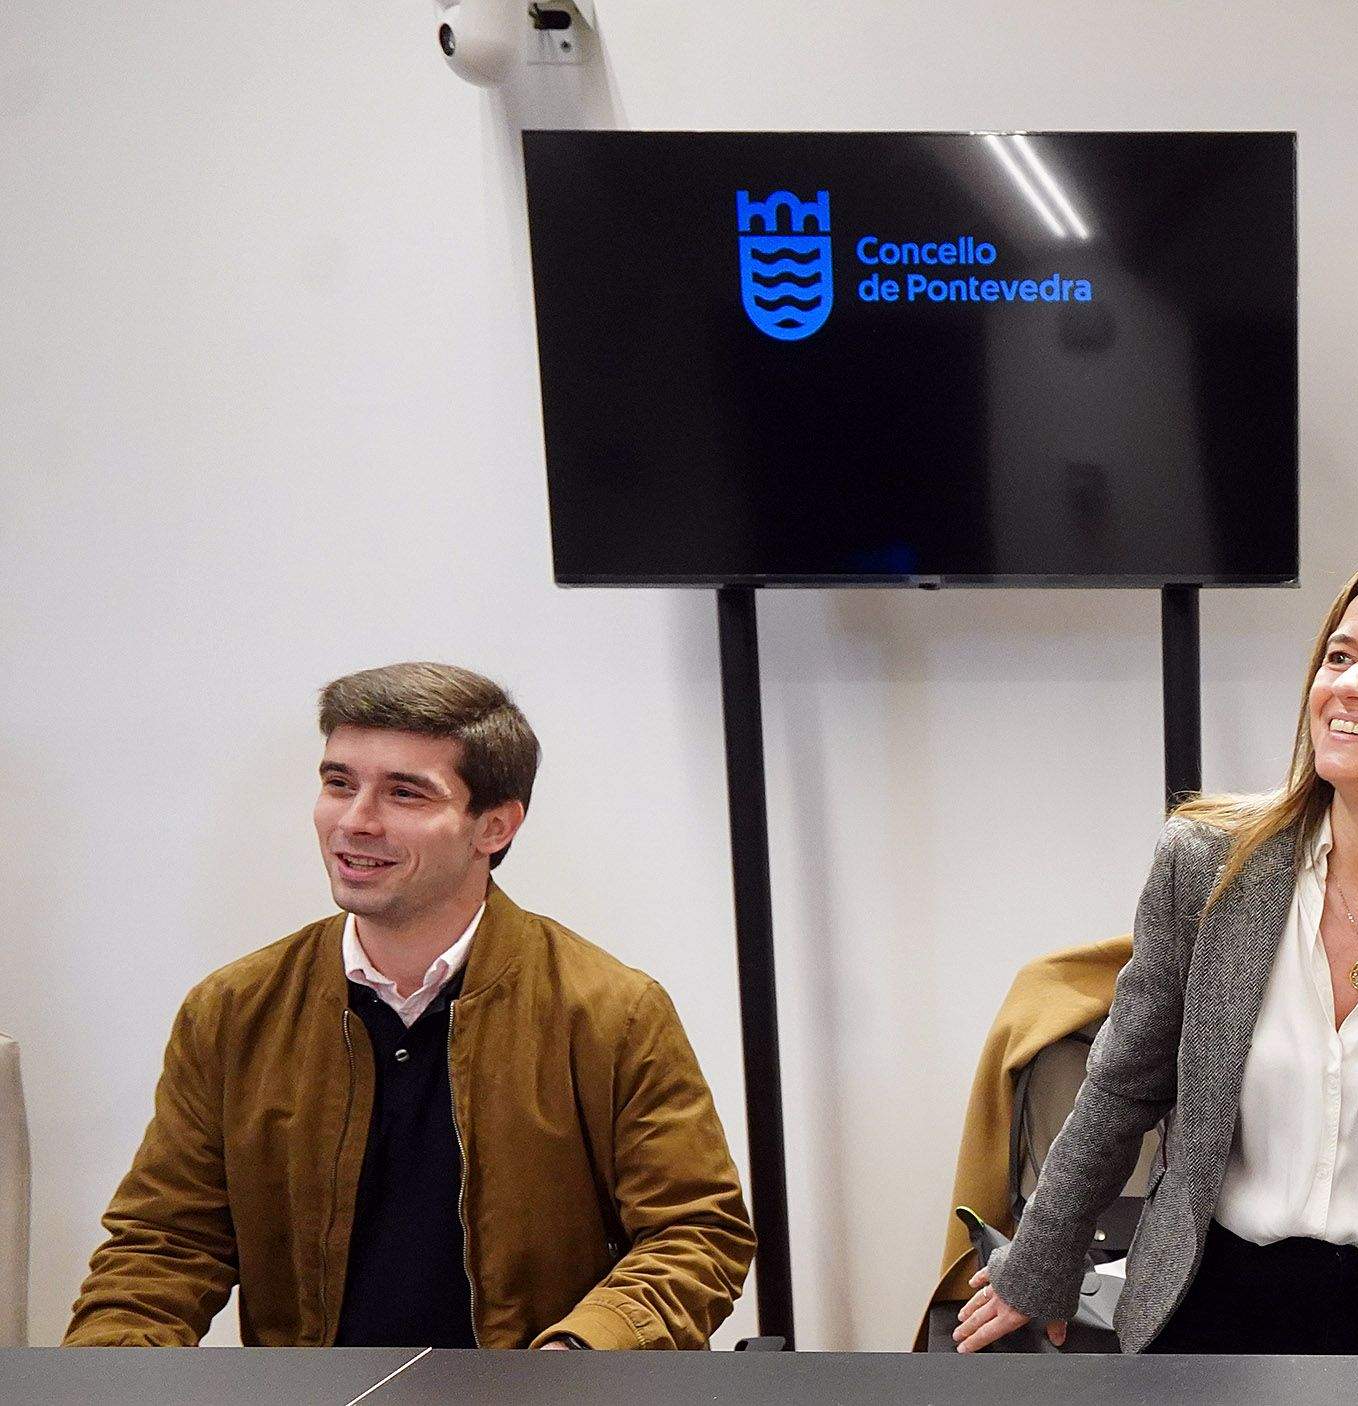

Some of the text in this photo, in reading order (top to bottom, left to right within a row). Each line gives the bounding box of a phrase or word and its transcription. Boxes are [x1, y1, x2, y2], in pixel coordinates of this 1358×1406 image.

[856, 236, 997, 265] Concello
[857, 272, 1092, 303] de Pontevedra
